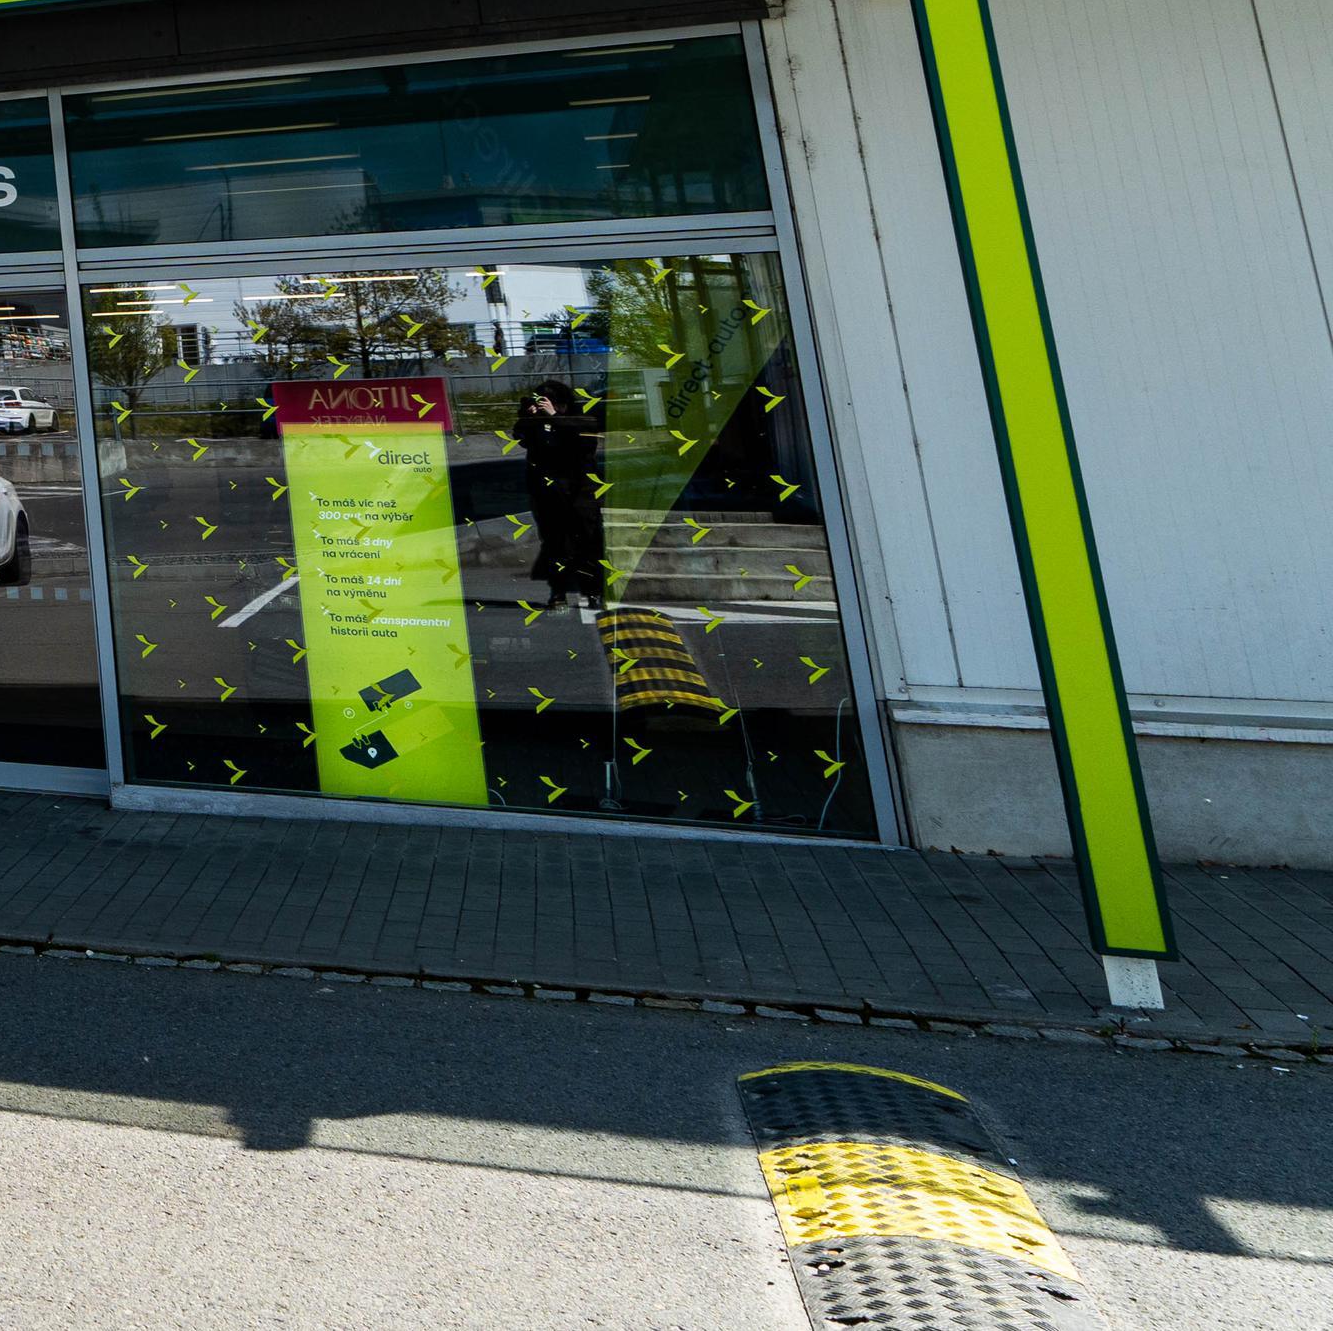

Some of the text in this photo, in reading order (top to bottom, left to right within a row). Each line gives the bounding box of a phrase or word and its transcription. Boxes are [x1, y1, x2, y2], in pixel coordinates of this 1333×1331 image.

[378, 450, 431, 465] direct
[317, 498, 397, 508] To máš víc než
[318, 511, 341, 520] 300
[382, 513, 414, 522] výběr
[321, 536, 393, 549] To máš 3 dny
[339, 550, 381, 559] vrácení
[325, 574, 403, 586] To máš 14 dní
[344, 588, 387, 599] výměnu
[329, 613, 342, 622] To
[345, 613, 369, 623] máš
[331, 626, 398, 638] historii auta
